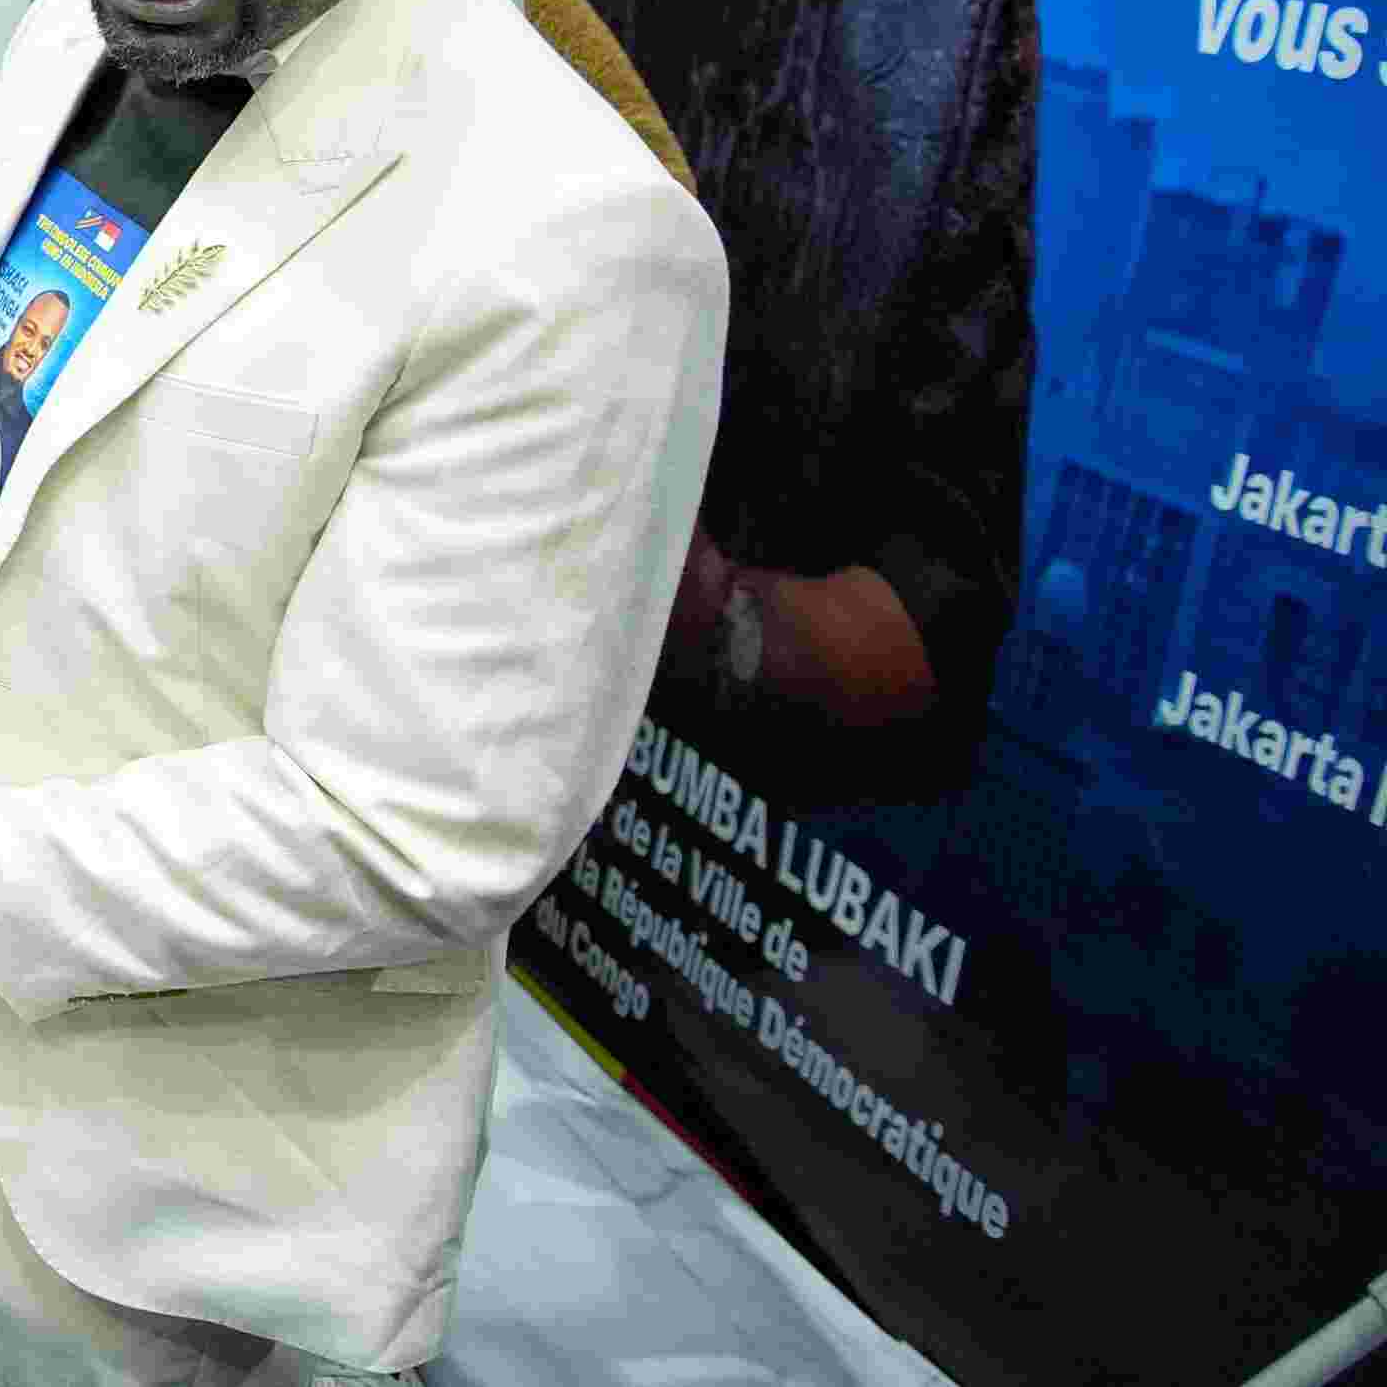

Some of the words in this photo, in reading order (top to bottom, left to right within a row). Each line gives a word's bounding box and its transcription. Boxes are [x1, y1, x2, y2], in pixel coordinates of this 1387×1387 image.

[1155, 670, 1364, 812] Jakarta
[569, 920, 651, 1020] Congo
[614, 800, 652, 857] de
[651, 825, 683, 884] la
[690, 850, 763, 944] Ville
[763, 917, 809, 982] de
[777, 819, 969, 1006] LUBAKI
[572, 843, 601, 899] la
[602, 866, 756, 1030] République
[758, 994, 1010, 1239] Démocratique
